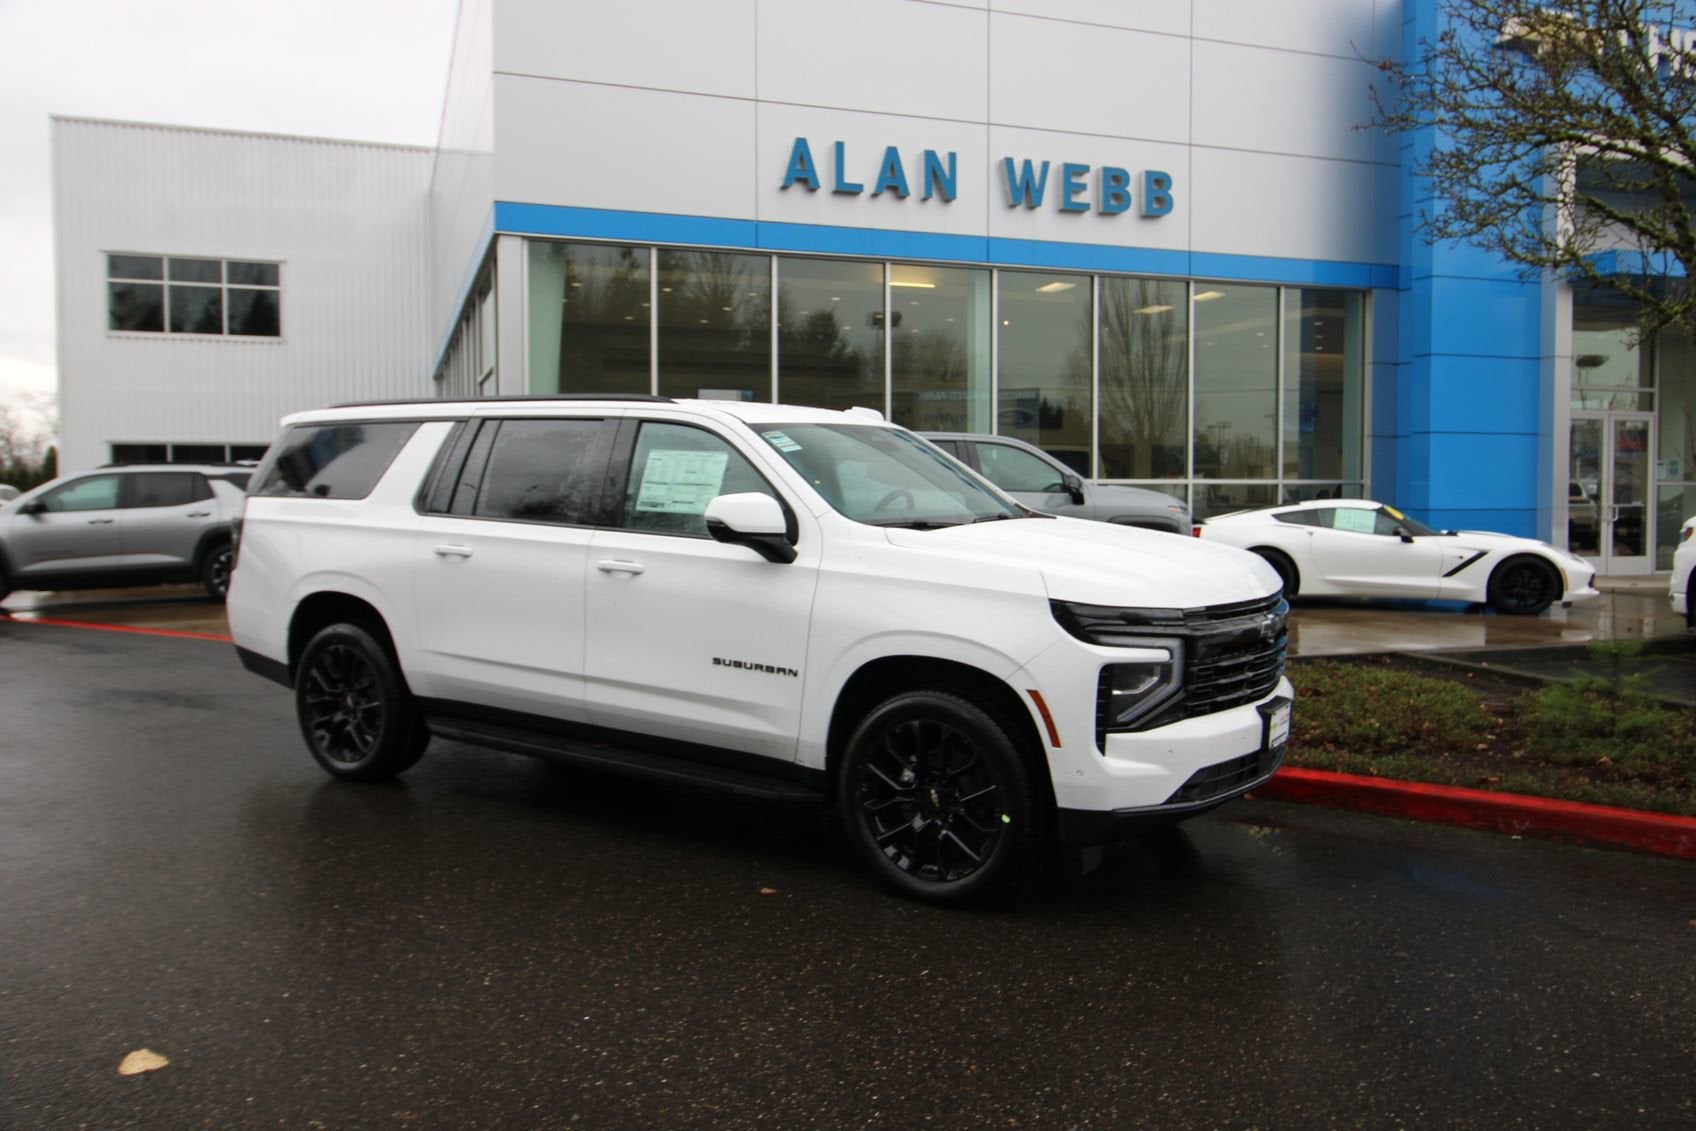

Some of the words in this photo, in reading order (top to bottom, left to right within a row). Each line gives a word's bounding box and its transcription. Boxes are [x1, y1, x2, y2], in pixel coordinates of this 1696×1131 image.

[780, 137, 957, 202] ALAN
[1003, 156, 1175, 217] WEBB
[712, 657, 799, 678] SUBURBAN
